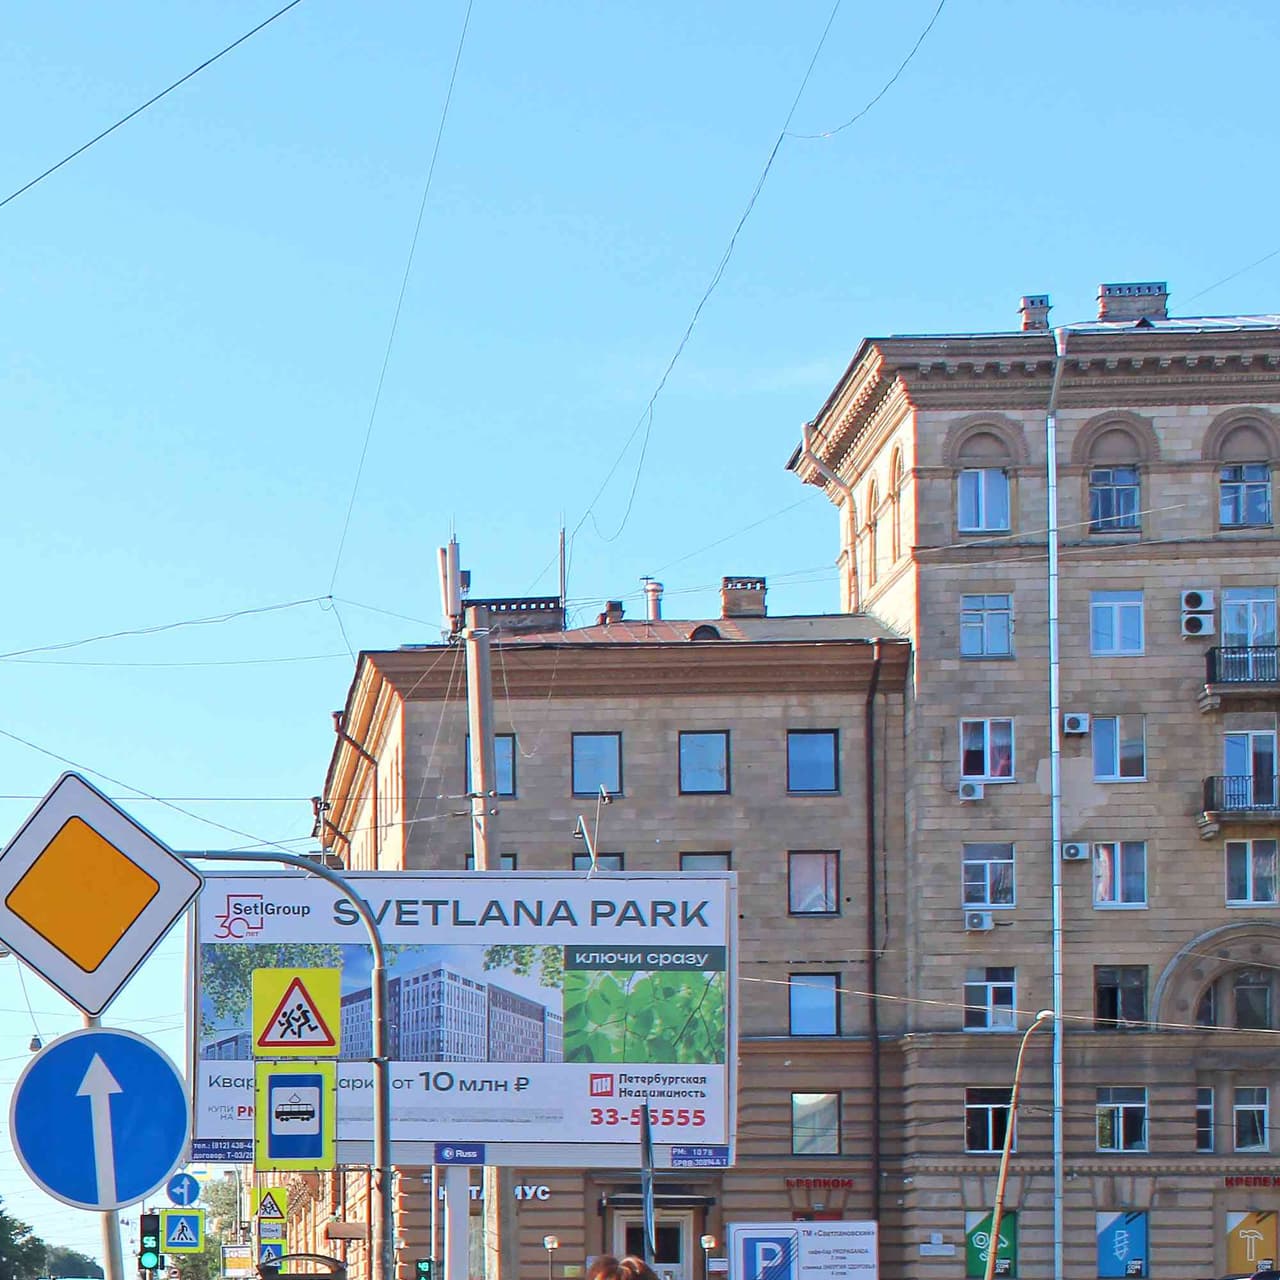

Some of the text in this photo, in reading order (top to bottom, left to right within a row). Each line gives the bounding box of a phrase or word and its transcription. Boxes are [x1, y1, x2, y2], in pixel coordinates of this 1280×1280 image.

[333, 898, 709, 927] SVETLANA PARK
[575, 952, 709, 967] ключи сразу
[208, 1075, 256, 1091] Квар
[338, 1078, 375, 1092] арк
[392, 1078, 414, 1090] от
[418, 1071, 455, 1092] 10
[459, 1078, 509, 1092] млн
[618, 1073, 707, 1086] Петербургская
[618, 1087, 706, 1099] Недвижимость
[590, 1108, 706, 1127] 33-55555
[455, 1149, 478, 1158] Russ
[755, 1241, 783, 1280] P
